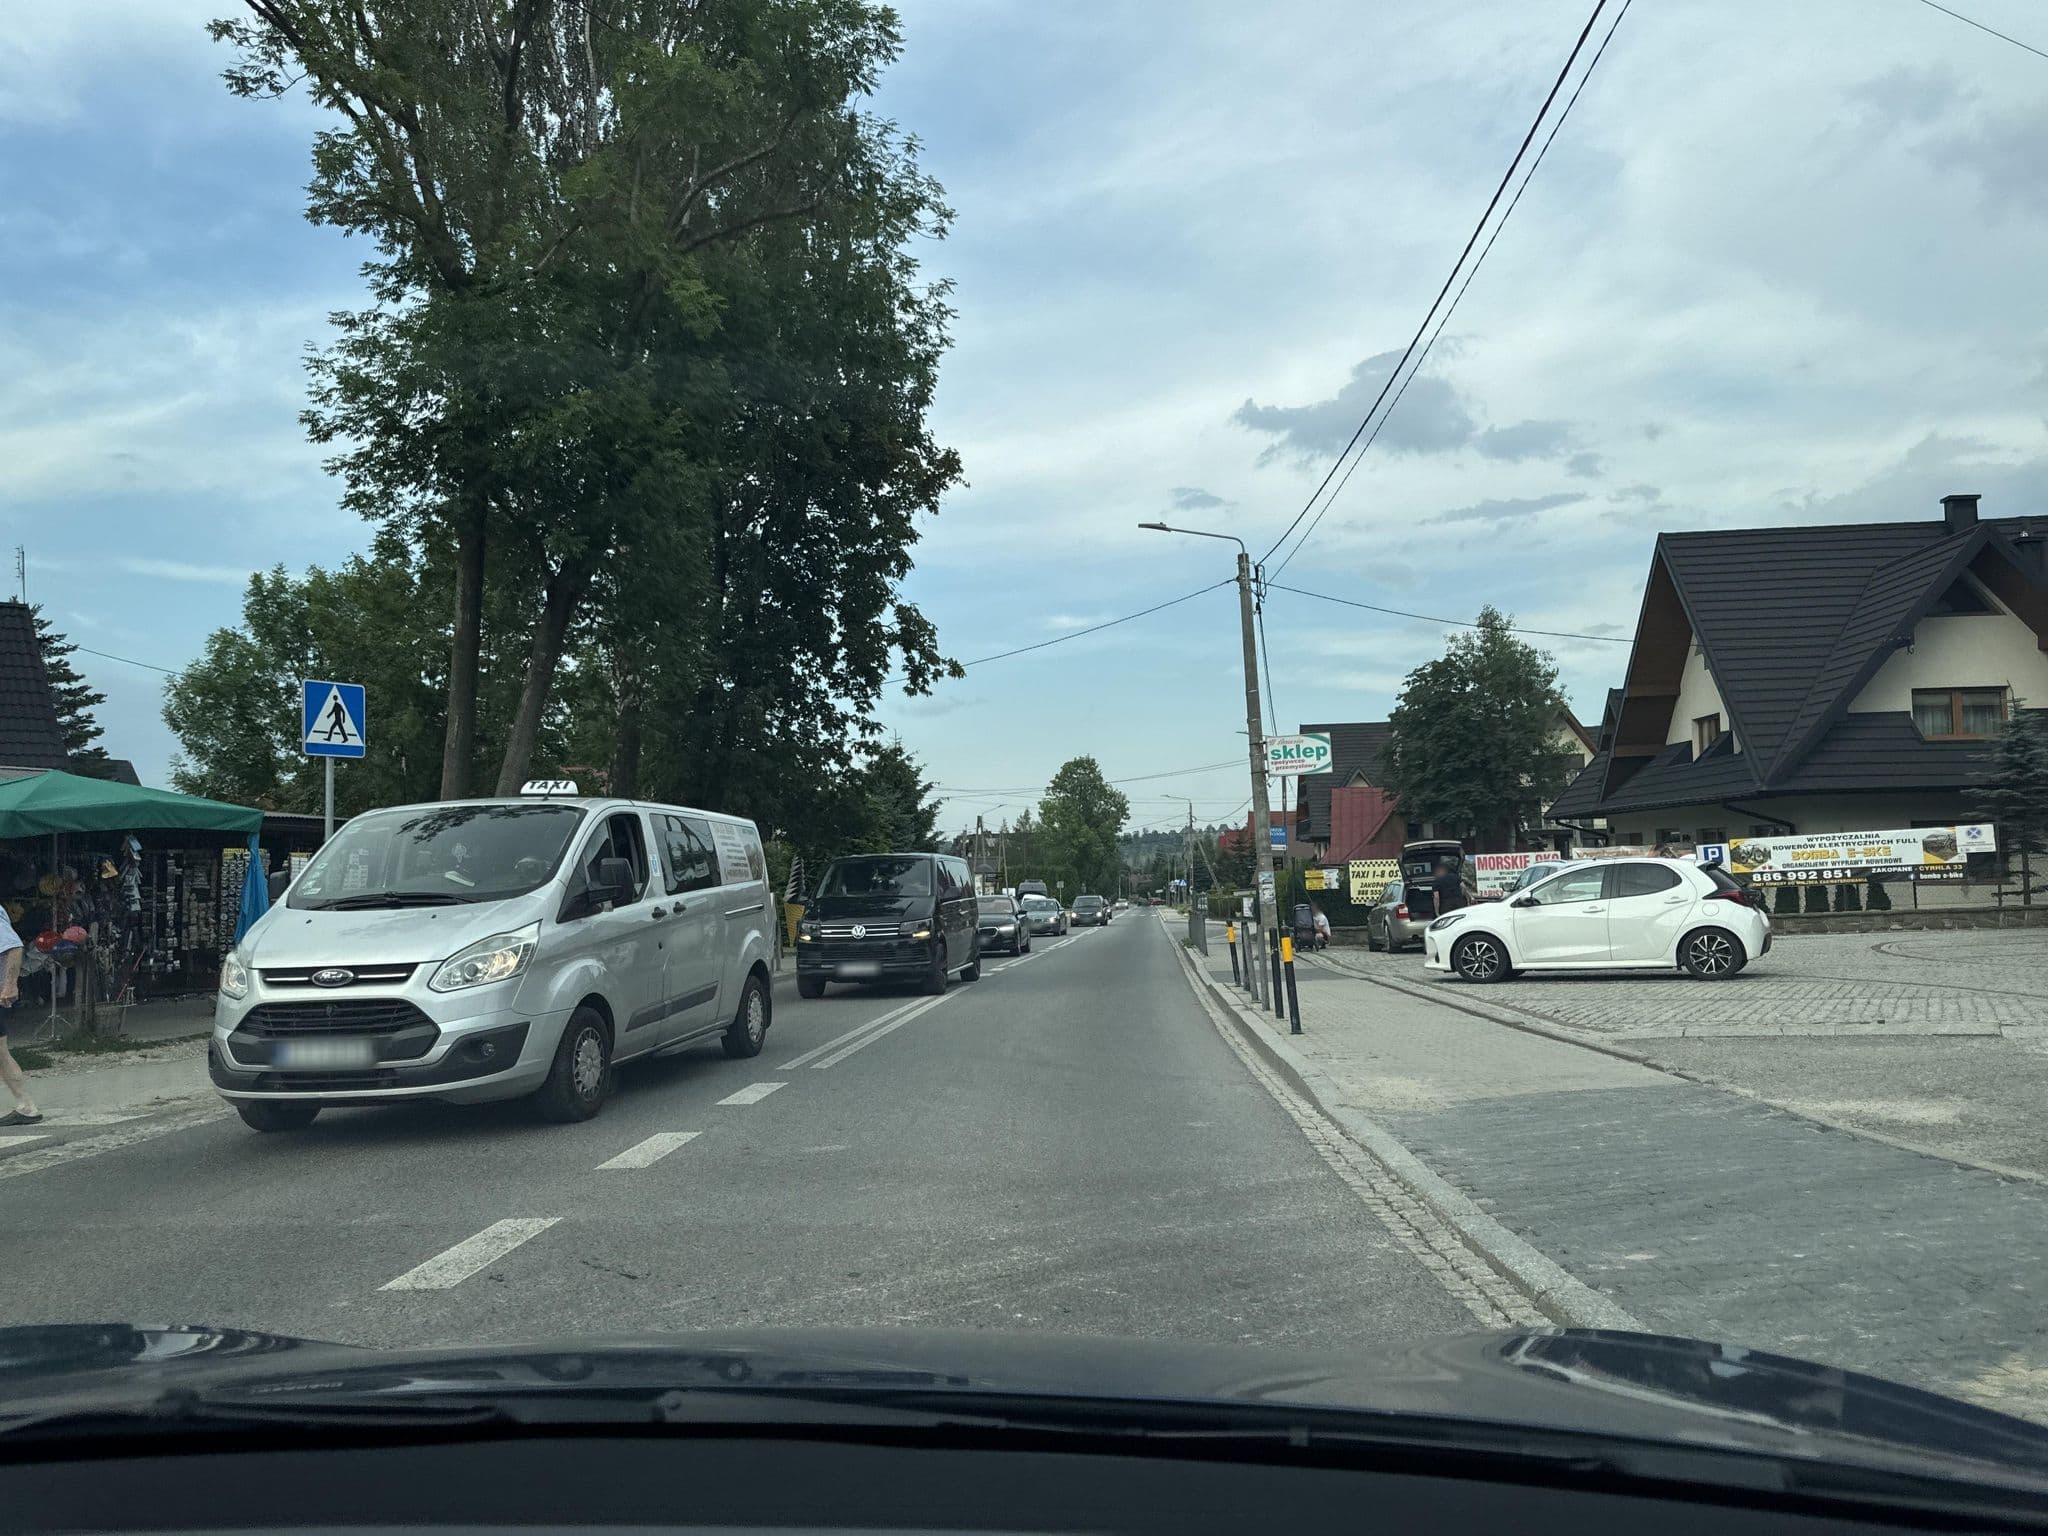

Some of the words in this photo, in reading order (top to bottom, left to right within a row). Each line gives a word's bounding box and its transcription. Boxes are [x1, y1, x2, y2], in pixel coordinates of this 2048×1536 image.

[1270, 744, 1328, 760] sklep
[529, 781, 571, 789] TAXI
[1772, 842, 1816, 850] ROWERÓW
[1818, 839, 1893, 849] ELEKTRYCZNYCH
[1791, 849, 1840, 861] BOMBA
[1477, 854, 1530, 870] MORSKIE
[1782, 861, 1829, 869] ORGANIZUJEMY
[1831, 859, 1863, 867] WYPRAWY
[1351, 870, 1369, 879] TAXI
[1752, 872, 1782, 882] 886
[1787, 870, 1818, 880] 992
[1823, 869, 1851, 879] 851
